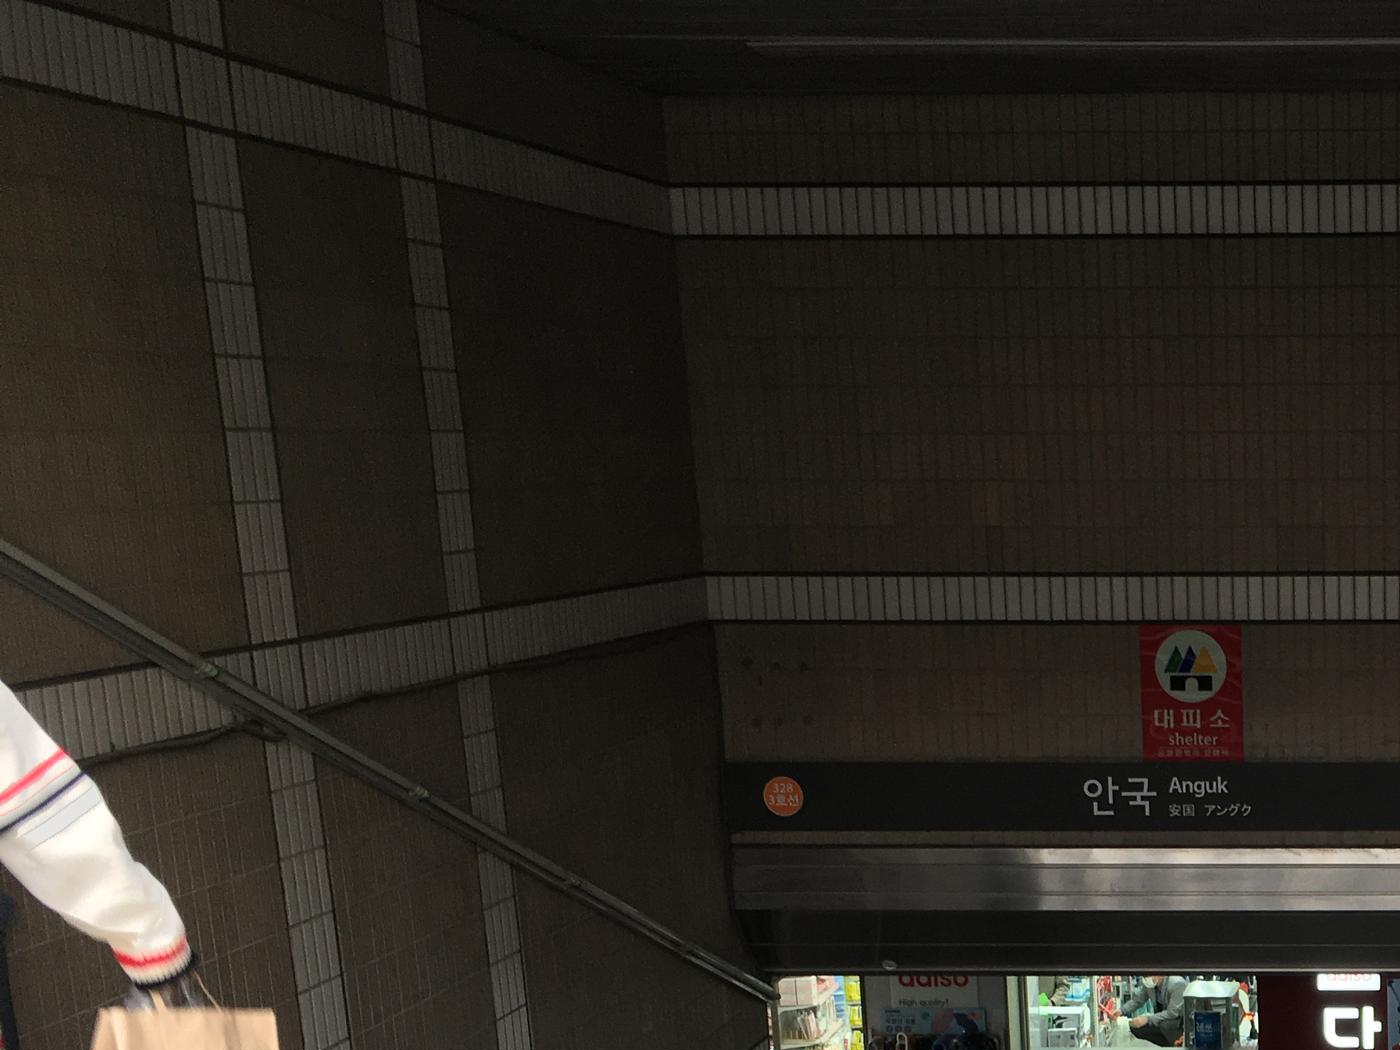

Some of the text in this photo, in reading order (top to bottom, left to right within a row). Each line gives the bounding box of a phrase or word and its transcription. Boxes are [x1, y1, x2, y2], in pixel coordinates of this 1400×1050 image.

[1153, 708, 1231, 729] 대피소
[1168, 732, 1218, 746] shelter
[772, 783, 794, 793] 328
[1169, 776, 1229, 798] Anguk
[768, 793, 800, 807] 3호선
[1083, 776, 1157, 816] 안국
[1169, 803, 1252, 817] 安国 アングク
